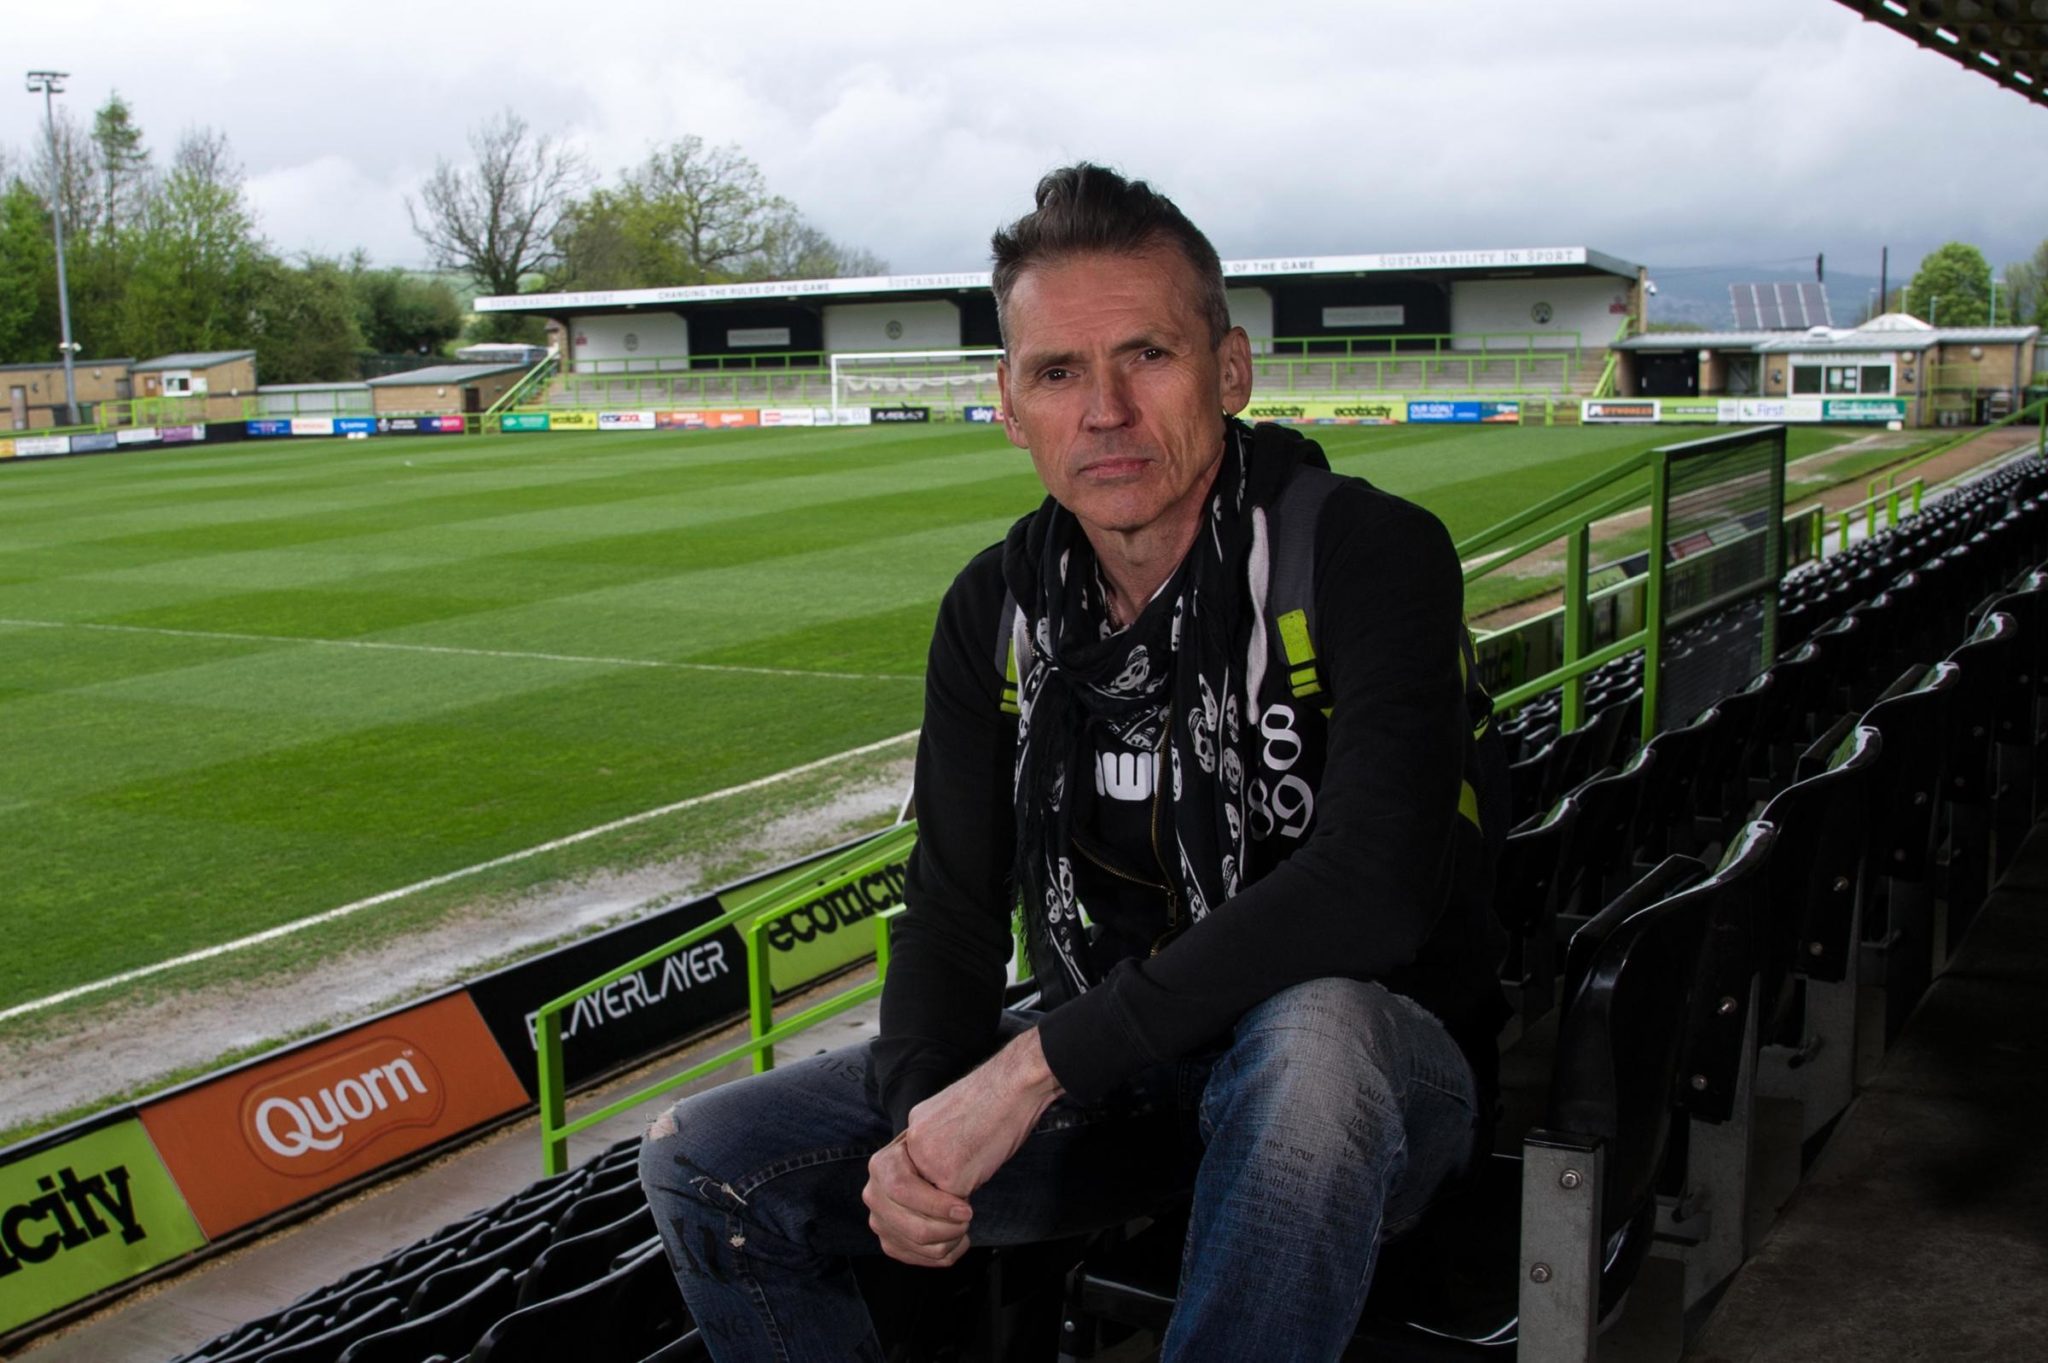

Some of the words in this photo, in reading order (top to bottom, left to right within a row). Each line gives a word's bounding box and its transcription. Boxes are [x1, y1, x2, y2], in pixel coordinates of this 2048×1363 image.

[1254, 262, 1276, 272] THE
[1281, 260, 1315, 271] GAME
[1379, 253, 1496, 267] SUSTAINABILITY
[1527, 250, 1574, 262] SPORT
[658, 290, 706, 300] CHANGING
[710, 288, 726, 297] THE
[730, 286, 761, 296] RULES
[802, 282, 831, 292] GAME
[1250, 405, 1305, 419] ecotricity
[1334, 405, 1392, 419] ecotricity
[1260, 703, 1302, 771] 8
[255, 1057, 428, 1157] Quorn
